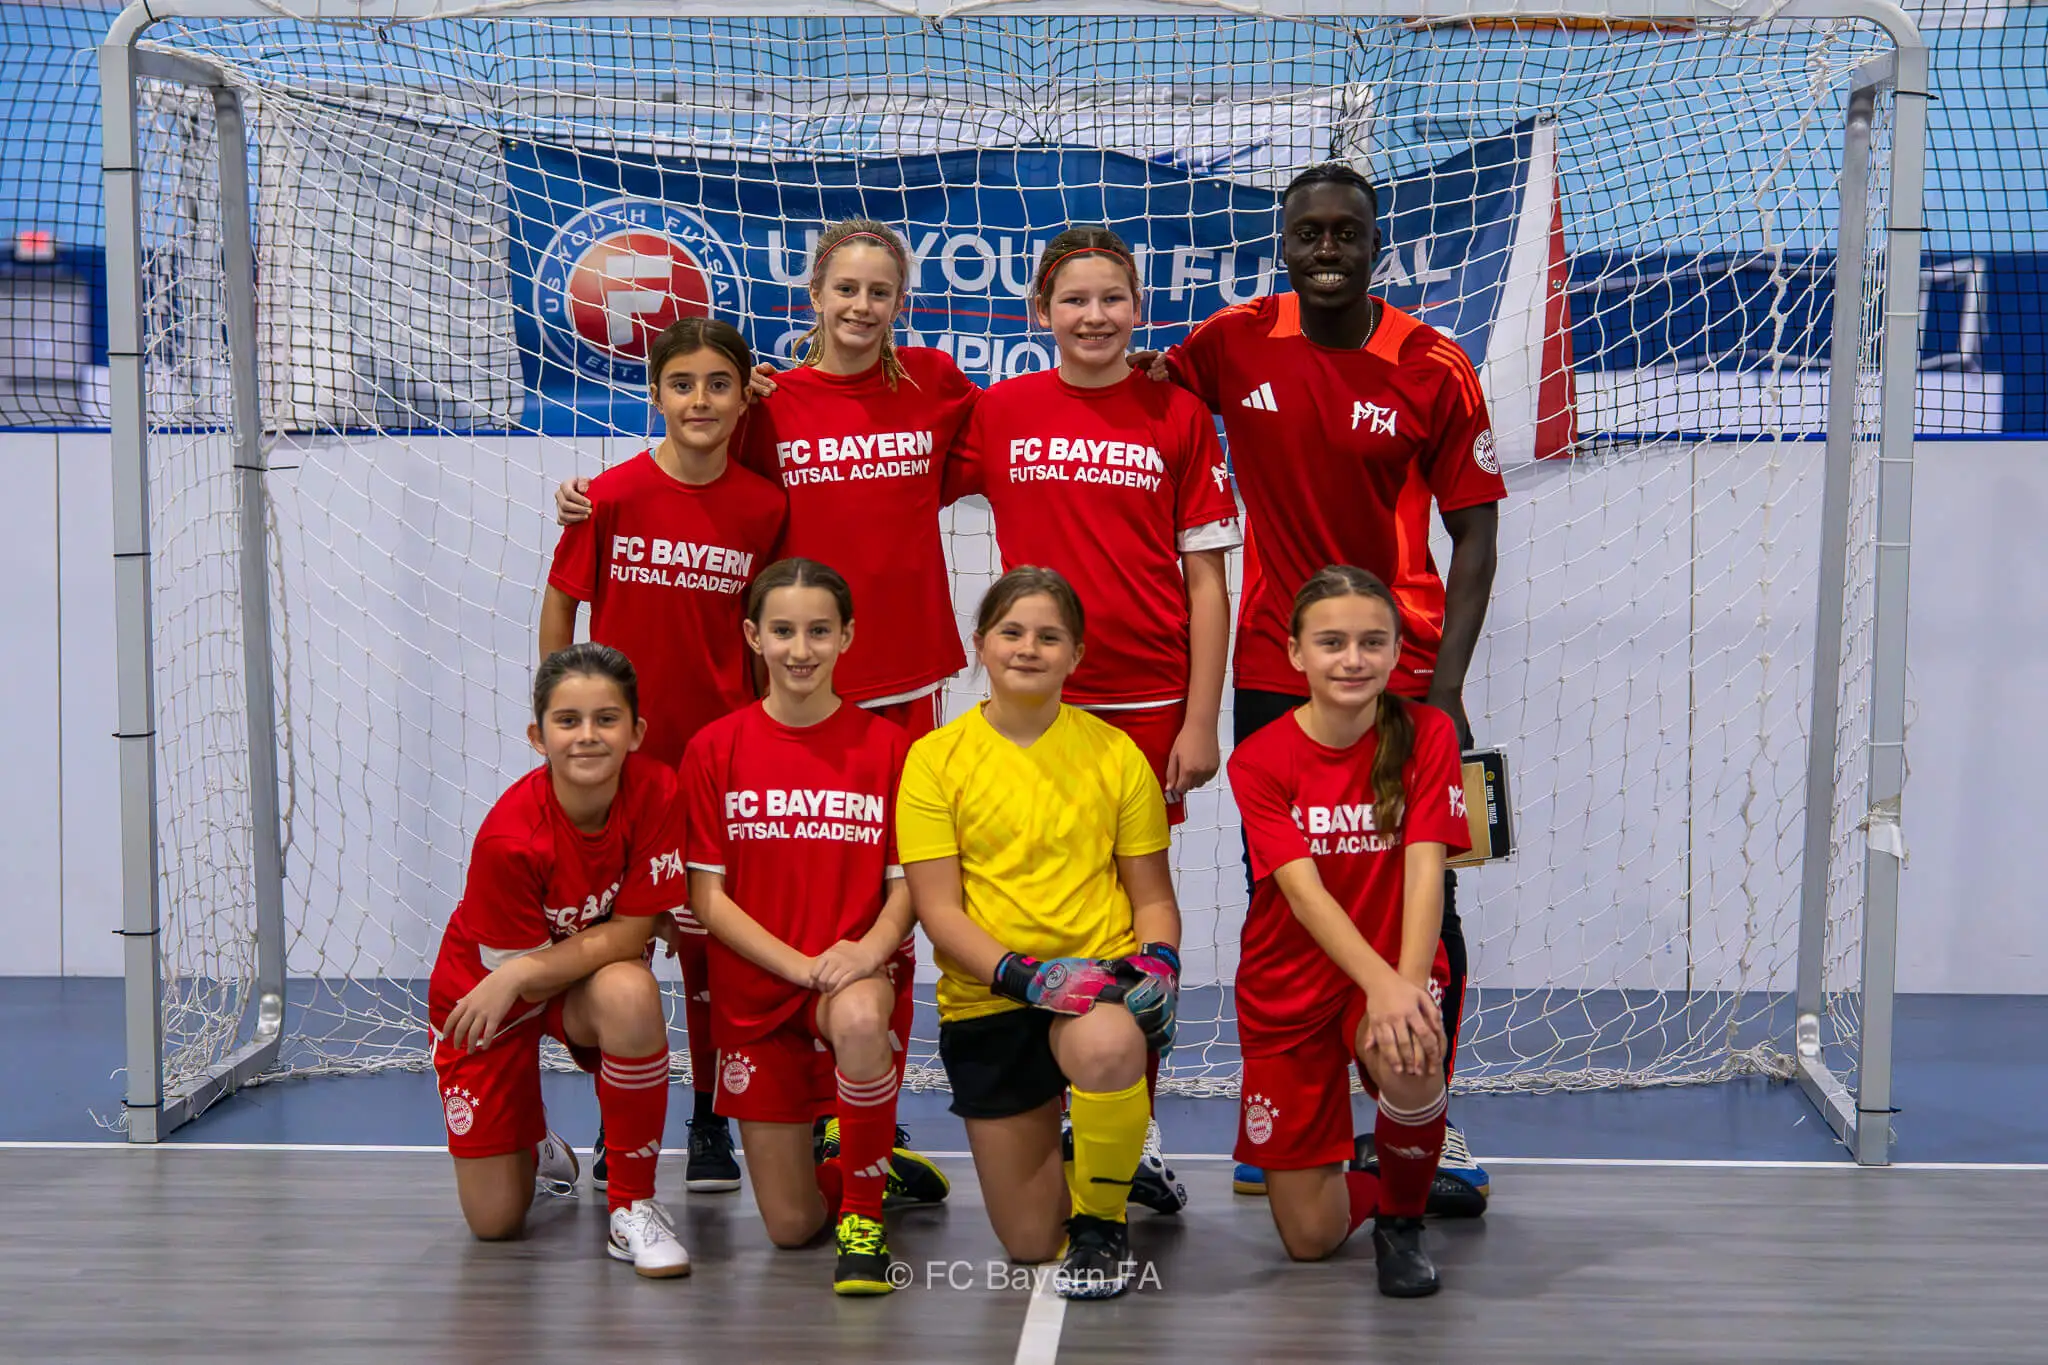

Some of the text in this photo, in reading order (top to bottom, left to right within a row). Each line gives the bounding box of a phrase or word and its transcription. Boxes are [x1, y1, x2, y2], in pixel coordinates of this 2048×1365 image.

[545, 208, 733, 313] US YOUTH FUTSAL
[776, 431, 933, 468] FC BAYERN
[1010, 437, 1164, 473] FC BAYERN
[781, 459, 930, 488] FUTSAL ACADEMY
[1009, 465, 1161, 492] FUTSAL ACADEMY
[612, 535, 754, 577] FC BAYERN
[610, 563, 672, 586] FUTSAL
[725, 789, 884, 823] FC BAYERN
[1308, 803, 1405, 834] BAYE
[727, 821, 883, 845] FUTSAL ACADEMY
